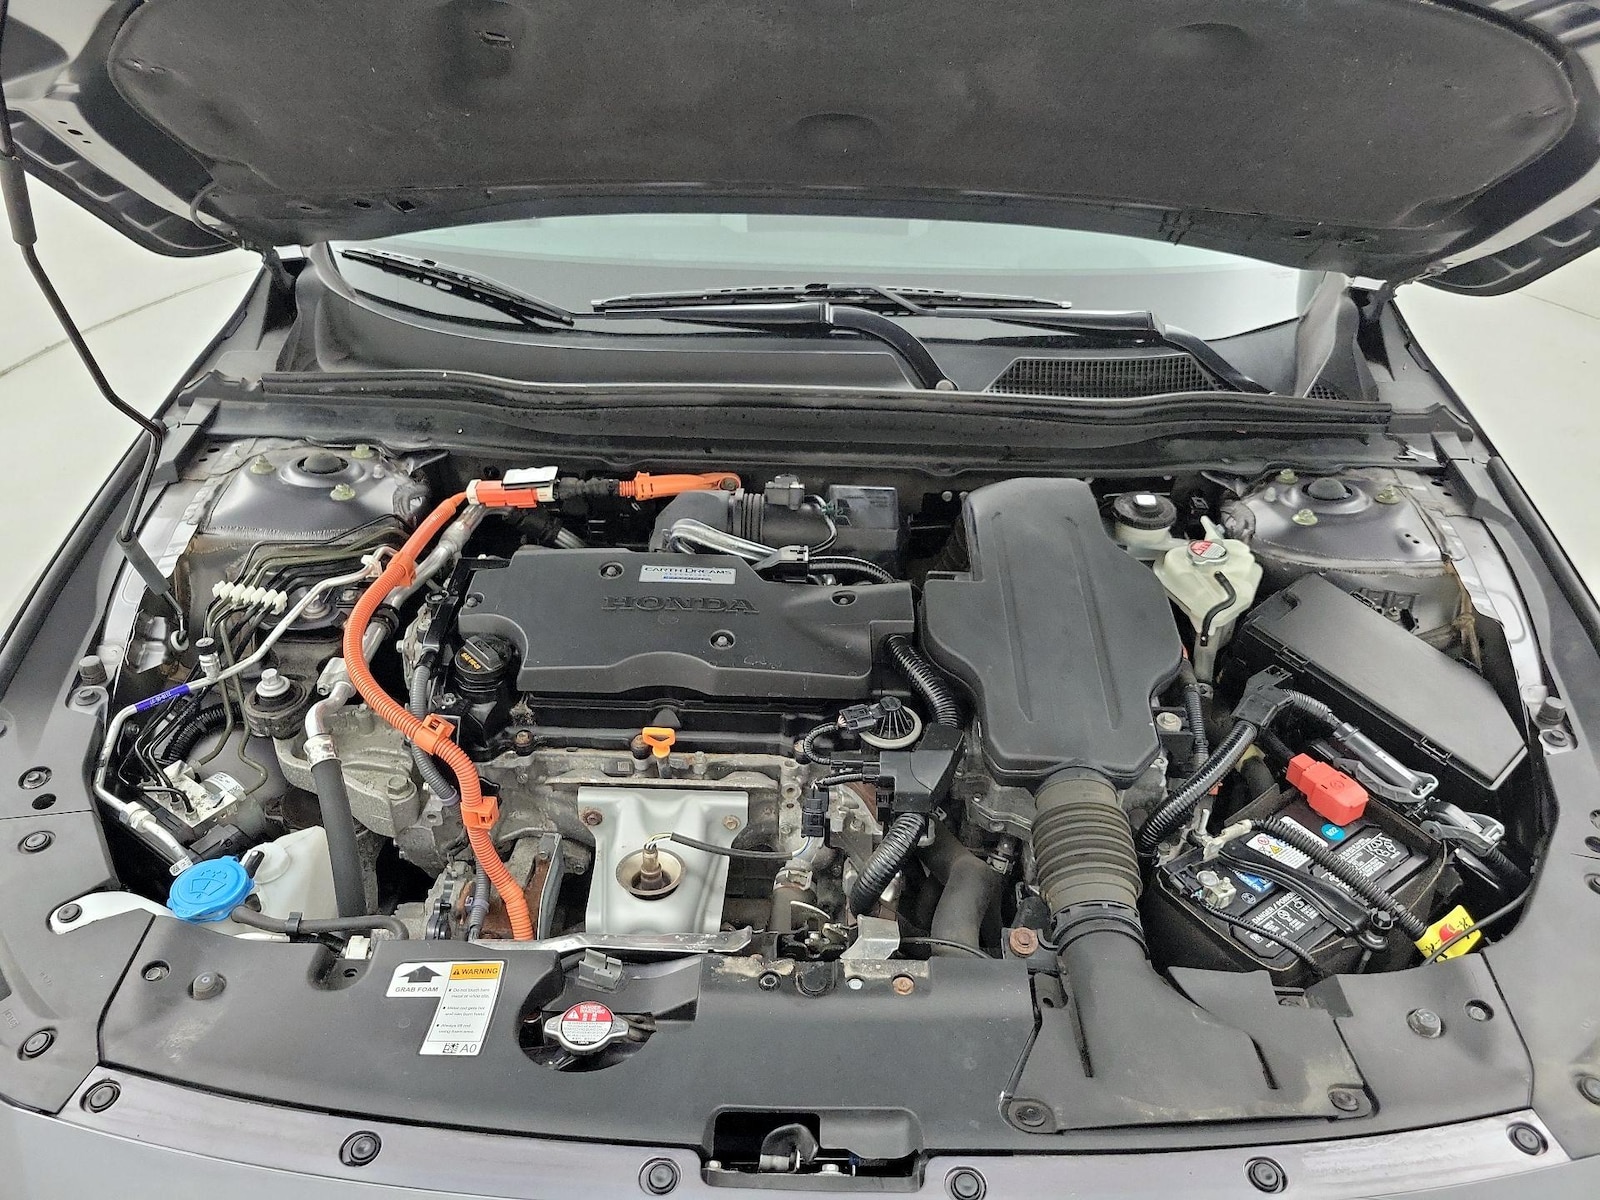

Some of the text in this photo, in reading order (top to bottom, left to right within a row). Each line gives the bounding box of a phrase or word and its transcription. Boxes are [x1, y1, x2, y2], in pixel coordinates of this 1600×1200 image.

[602, 595, 760, 614] HONDA
[1252, 906, 1276, 925] DANGER
[462, 967, 498, 975] WARNING
[460, 1044, 477, 1053] A0
